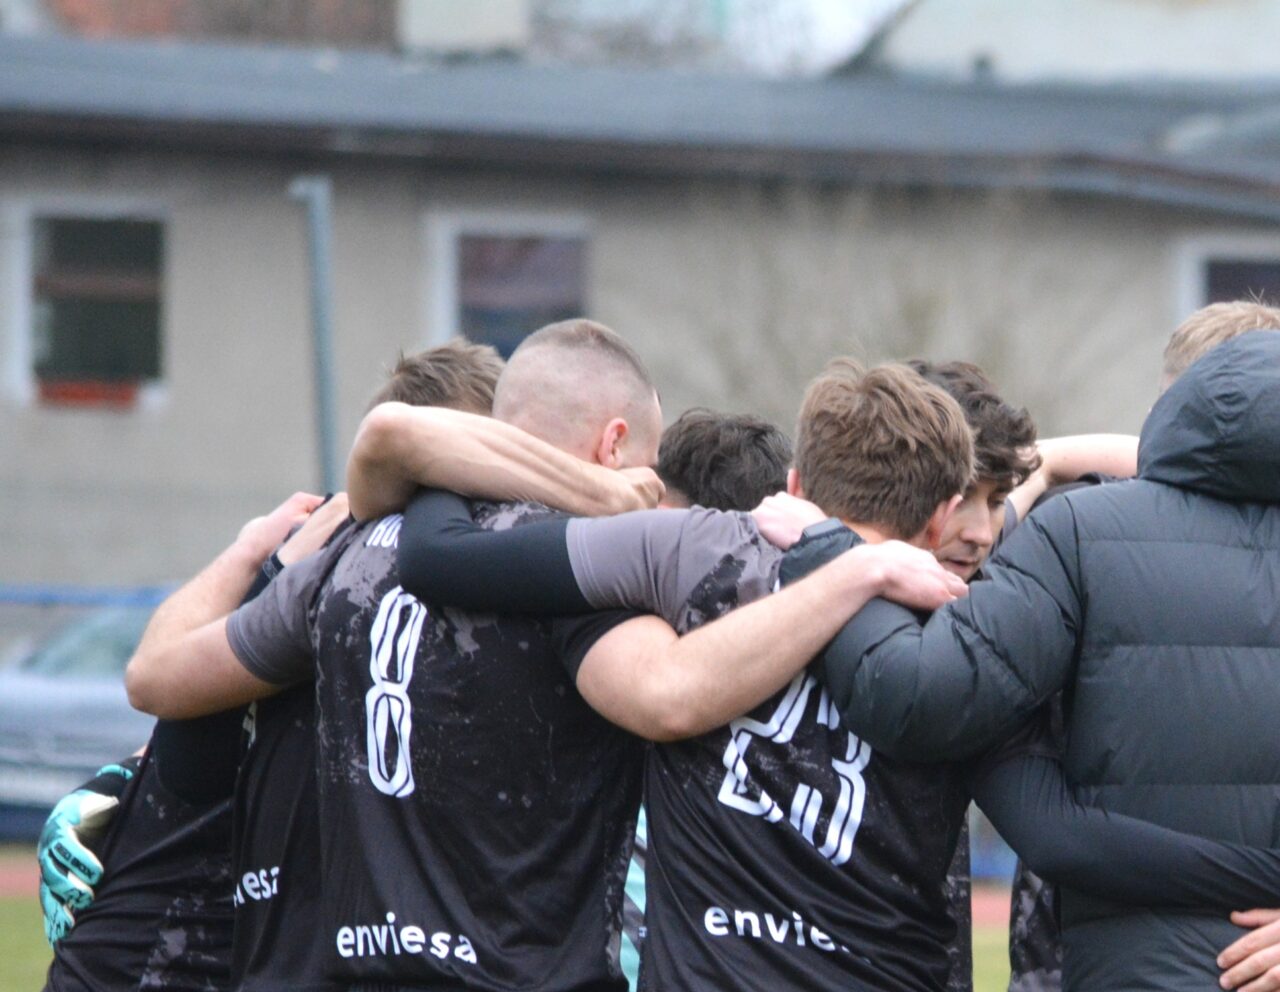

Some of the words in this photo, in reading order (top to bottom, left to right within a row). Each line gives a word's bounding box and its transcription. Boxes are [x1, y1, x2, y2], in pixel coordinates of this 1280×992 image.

[365, 584, 428, 798] 8
[336, 911, 477, 965] enviesa
[704, 906, 871, 964] envie
